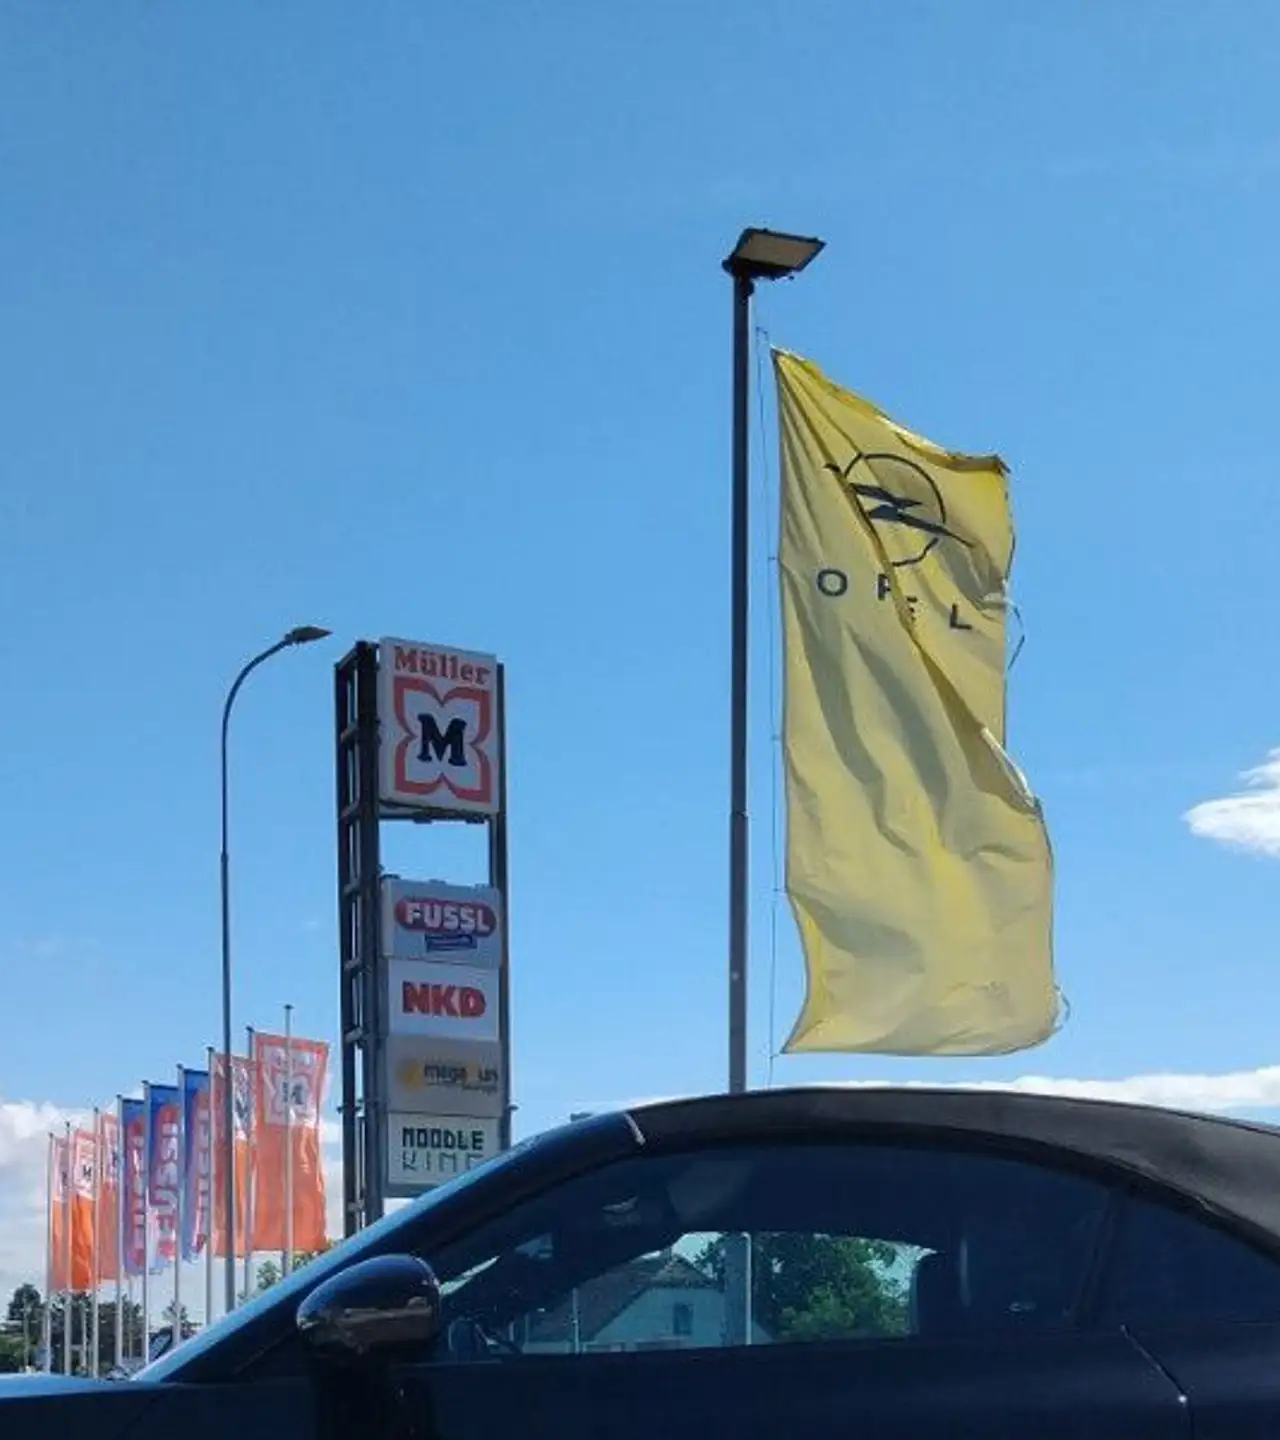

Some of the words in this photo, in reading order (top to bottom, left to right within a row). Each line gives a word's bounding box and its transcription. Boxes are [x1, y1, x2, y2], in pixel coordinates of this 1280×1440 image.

[394, 645, 491, 685] Müller
[417, 713, 467, 766] M
[406, 902, 490, 933] FUSSL
[402, 981, 486, 1017] NKD
[402, 1127, 484, 1150] NOODLE
